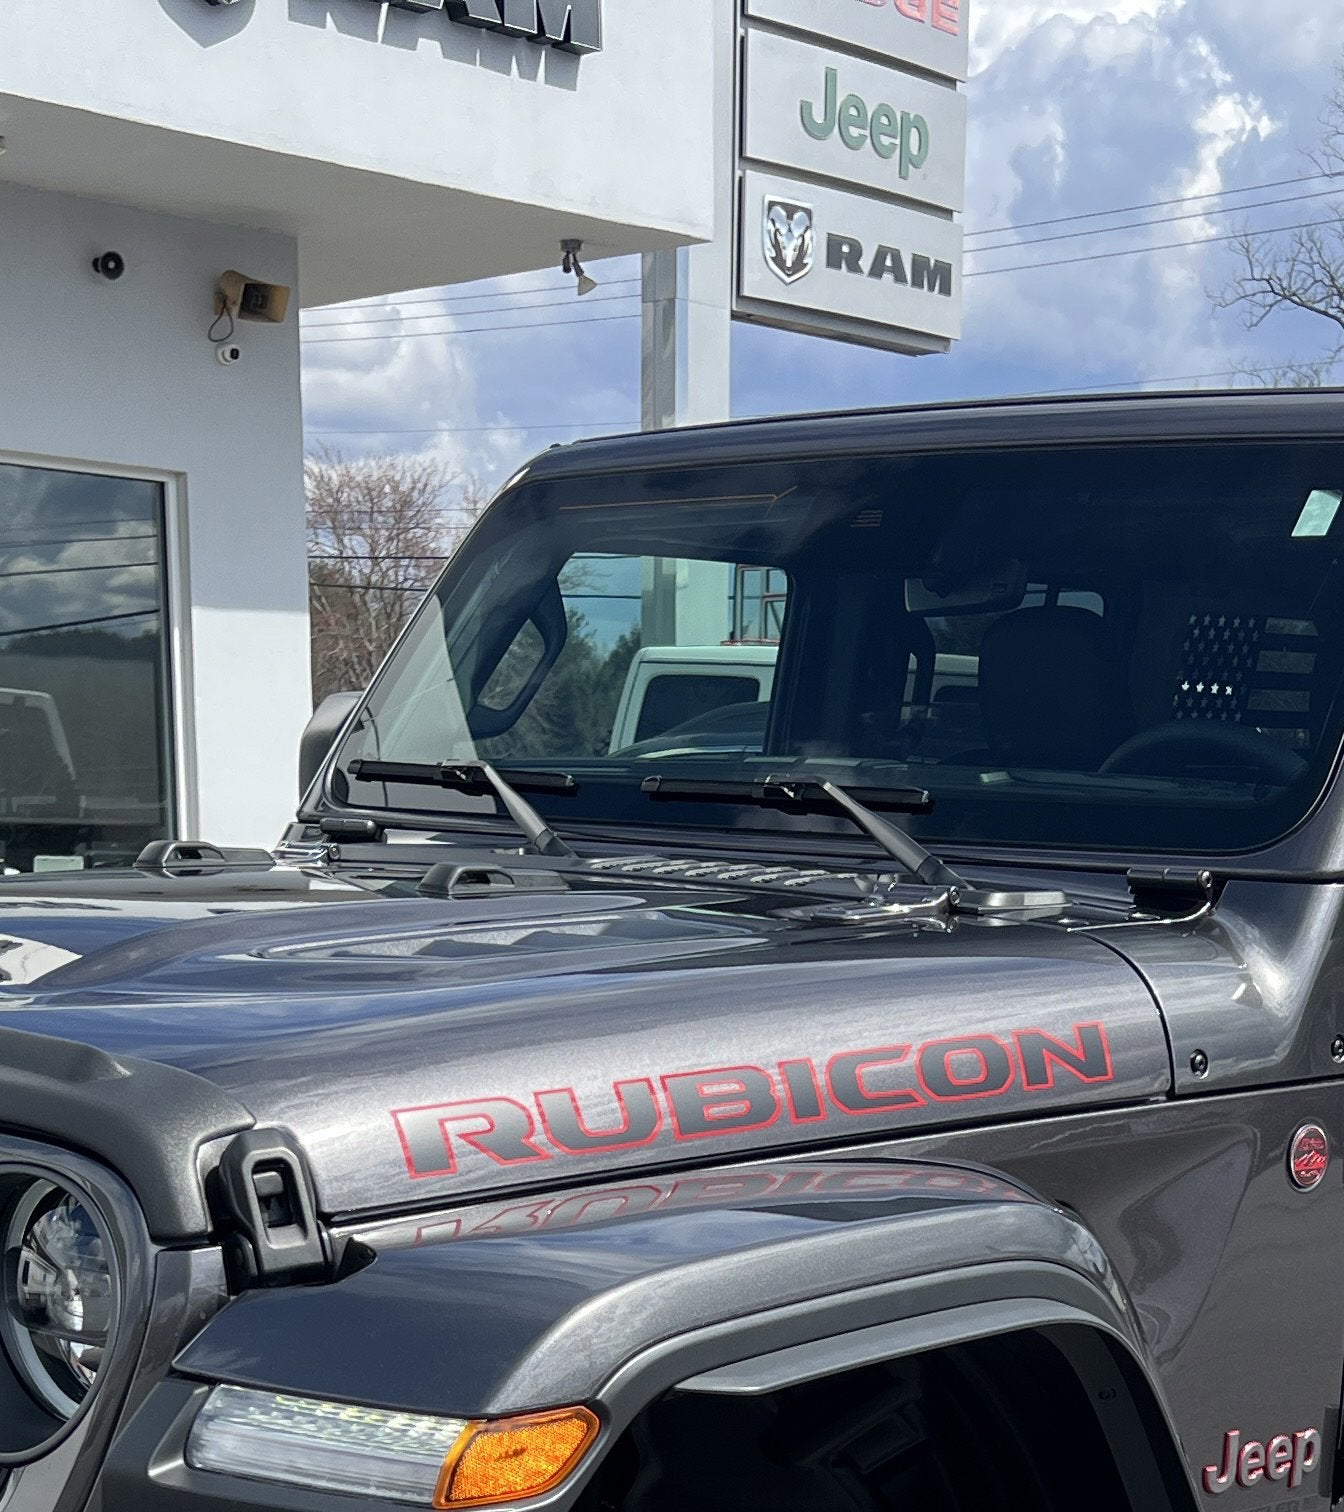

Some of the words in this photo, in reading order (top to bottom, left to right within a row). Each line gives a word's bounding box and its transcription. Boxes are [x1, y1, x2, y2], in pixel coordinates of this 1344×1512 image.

[799, 66, 930, 181] Jeep
[825, 232, 953, 297] RAM
[390, 1022, 1115, 1180] RUBICON
[1202, 1427, 1323, 1495] Jeep
